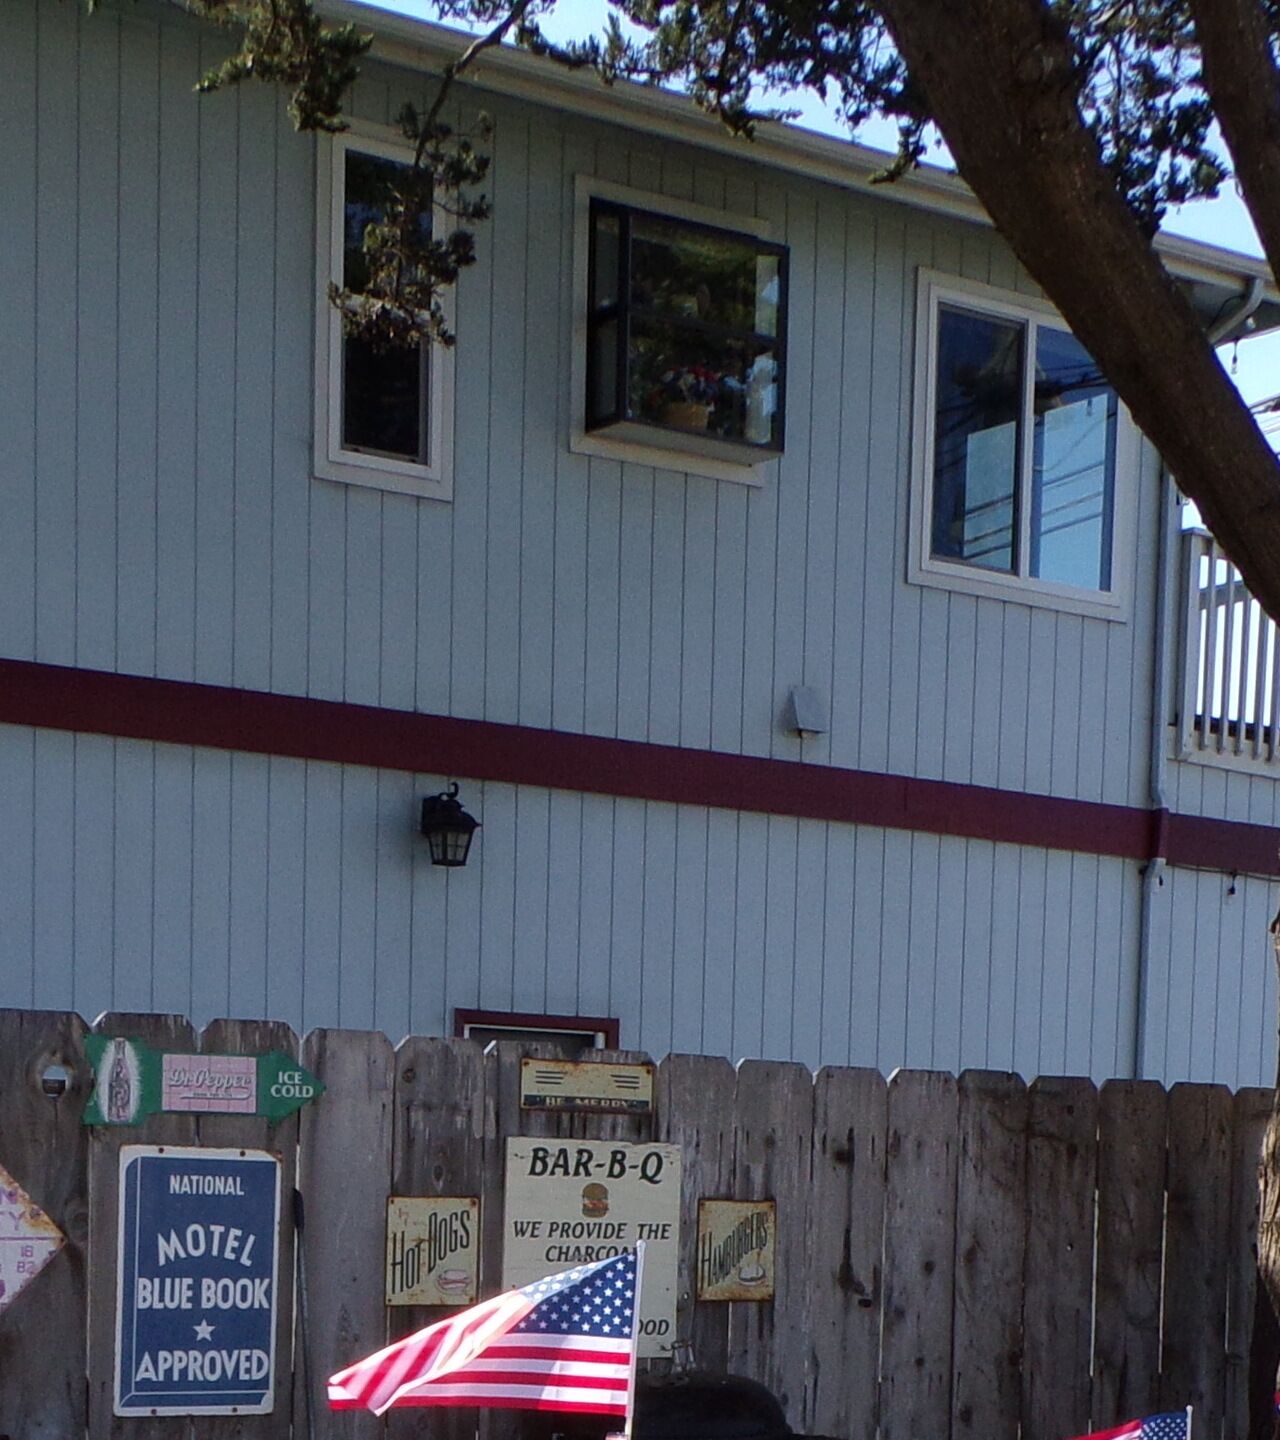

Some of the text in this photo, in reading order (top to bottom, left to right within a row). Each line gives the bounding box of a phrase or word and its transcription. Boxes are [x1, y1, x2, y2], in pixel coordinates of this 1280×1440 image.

[193, 1067, 252, 1096] Pepper
[278, 1071, 302, 1085] ICE
[271, 1084, 314, 1098] COLD
[528, 1147, 664, 1184] BAR-B-Q
[170, 1174, 244, 1196] NATIONAL
[513, 1221, 672, 1240] WE PROVIDE THE
[157, 1223, 256, 1267] MOTEL
[545, 1245, 637, 1262] CHARCOA
[137, 1278, 270, 1310] BLUE BOOK
[135, 1350, 269, 1382] APPROVED
